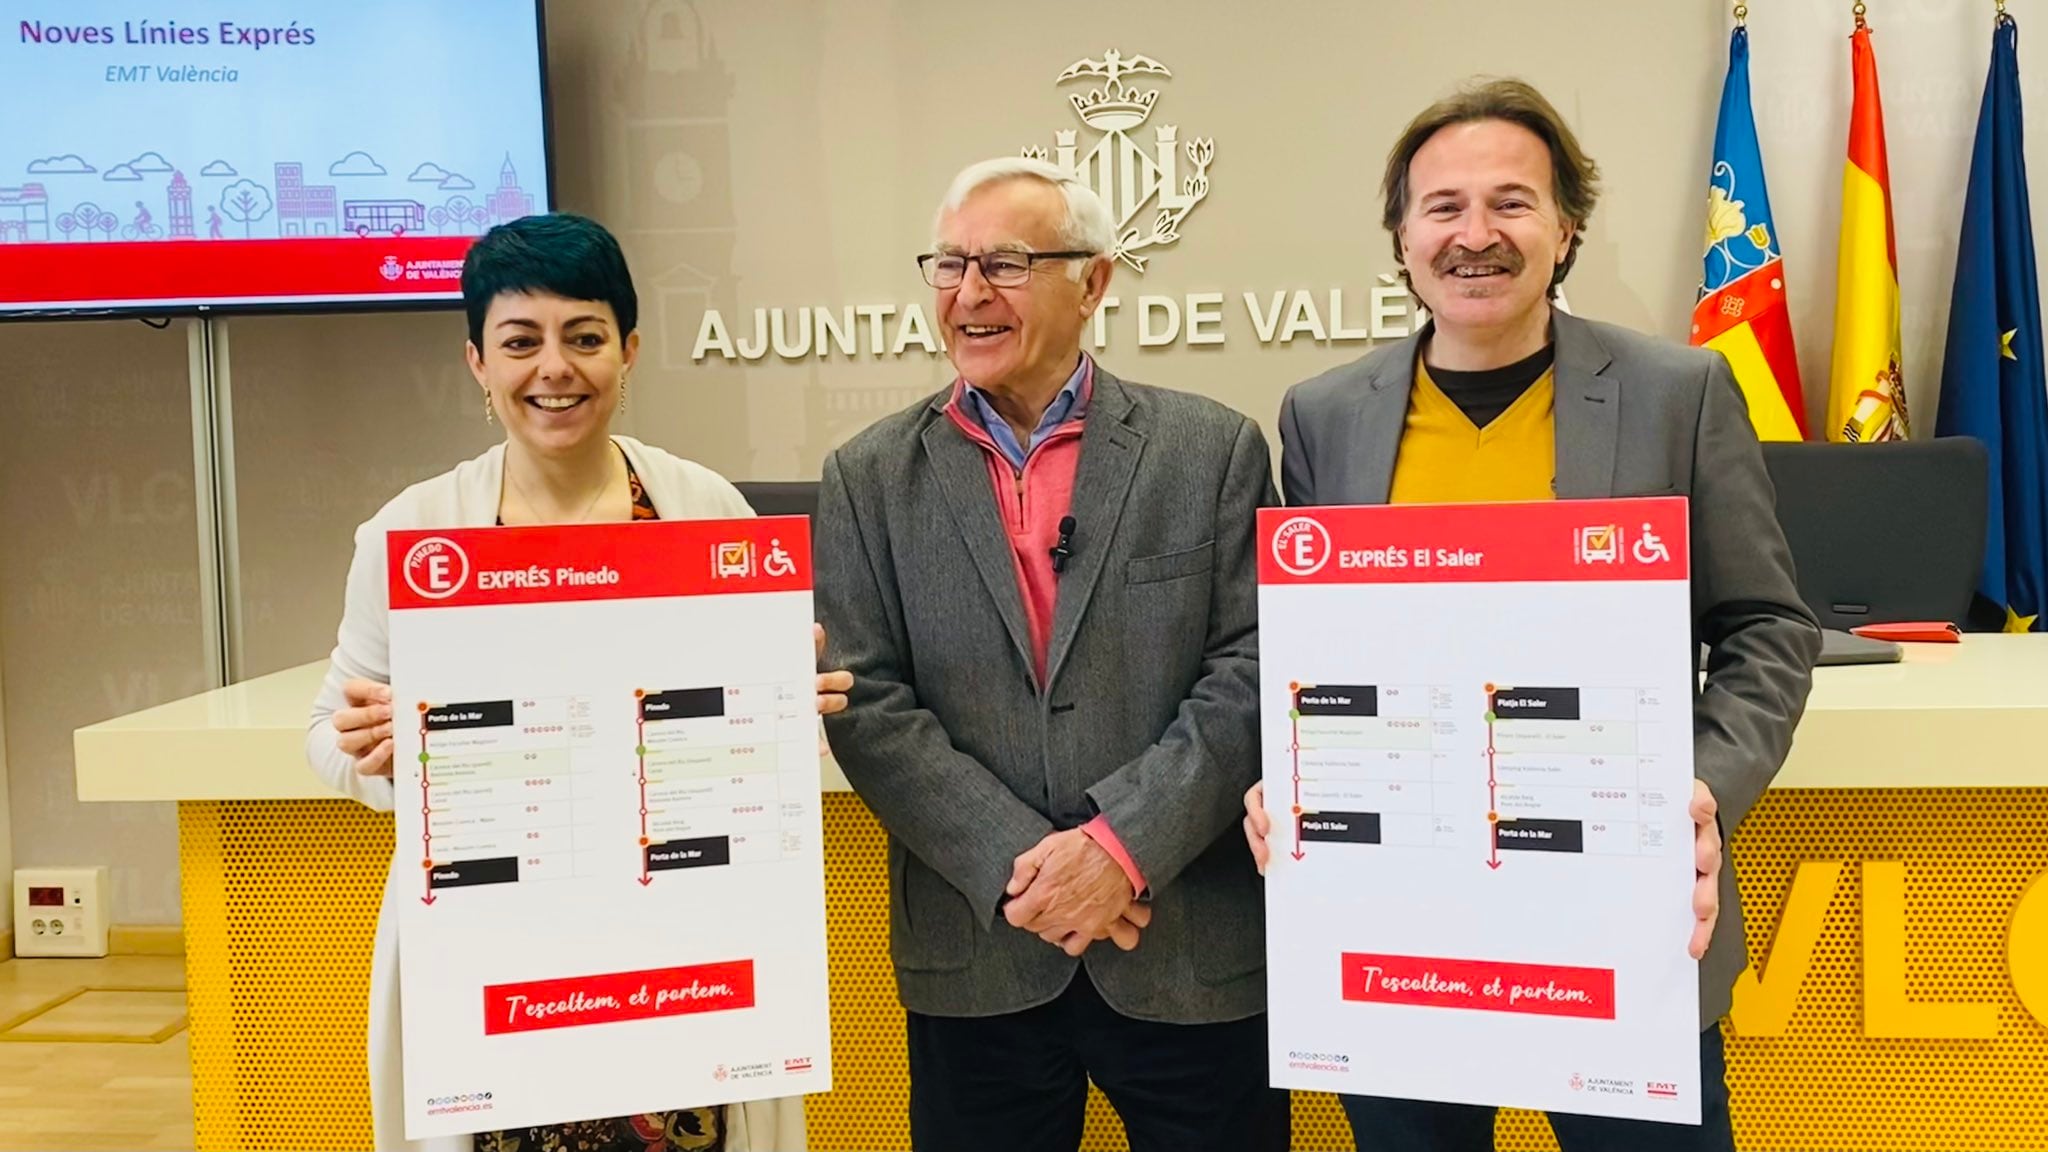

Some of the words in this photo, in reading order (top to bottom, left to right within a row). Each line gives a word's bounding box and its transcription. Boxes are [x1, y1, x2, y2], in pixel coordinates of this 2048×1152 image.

[20, 20, 114, 44] Noves
[124, 19, 210, 45] Línies
[219, 21, 316, 51] Exprés
[105, 65, 151, 83] EMT
[157, 65, 239, 83] València
[406, 270, 420, 280] DE
[690, 296, 1121, 360] AJUNTAT
[1137, 293, 1226, 347] DE
[410, 543, 443, 569] PINEDO
[1295, 533, 1315, 566] E
[1339, 546, 1408, 569] EXPRÉS
[1414, 549, 1431, 567] El
[1435, 549, 1484, 568] Saler
[429, 555, 452, 589] E
[477, 565, 551, 590] EXPRÉS
[556, 565, 619, 586] Pinedo
[644, 703, 670, 712] Pinedo
[1301, 696, 1319, 705] Porta
[1320, 696, 1329, 705] de
[1330, 696, 1337, 705] la
[1338, 696, 1352, 705] Mar
[1497, 698, 1519, 709] Platja
[1519, 699, 1527, 707] El
[1527, 699, 1547, 708] Saler
[428, 714, 448, 723] Porta
[449, 713, 459, 722] de
[460, 712, 467, 721] la
[468, 711, 483, 720] Mar
[1302, 820, 1322, 832] Platja
[1323, 821, 1330, 830] El
[1330, 821, 1348, 831] Saler
[1498, 828, 1518, 838] Porta
[1520, 829, 1529, 838] de
[1529, 829, 1537, 838] la
[1537, 830, 1553, 839] Mar
[650, 853, 669, 862] Porta
[670, 852, 679, 861] de
[680, 851, 687, 859] la
[688, 850, 702, 859] Mar
[433, 871, 460, 881] Pinedo
[1729, 861, 2048, 1038] VL
[1362, 966, 1475, 997] T'escoltem,
[1482, 976, 1503, 998] et
[1509, 981, 1594, 1006] portem.
[505, 991, 621, 1024] T'escoltem,
[628, 985, 650, 1007] et
[655, 980, 735, 1011] portem.
[784, 1056, 812, 1066] EMT
[1647, 1081, 1678, 1091] EMT
